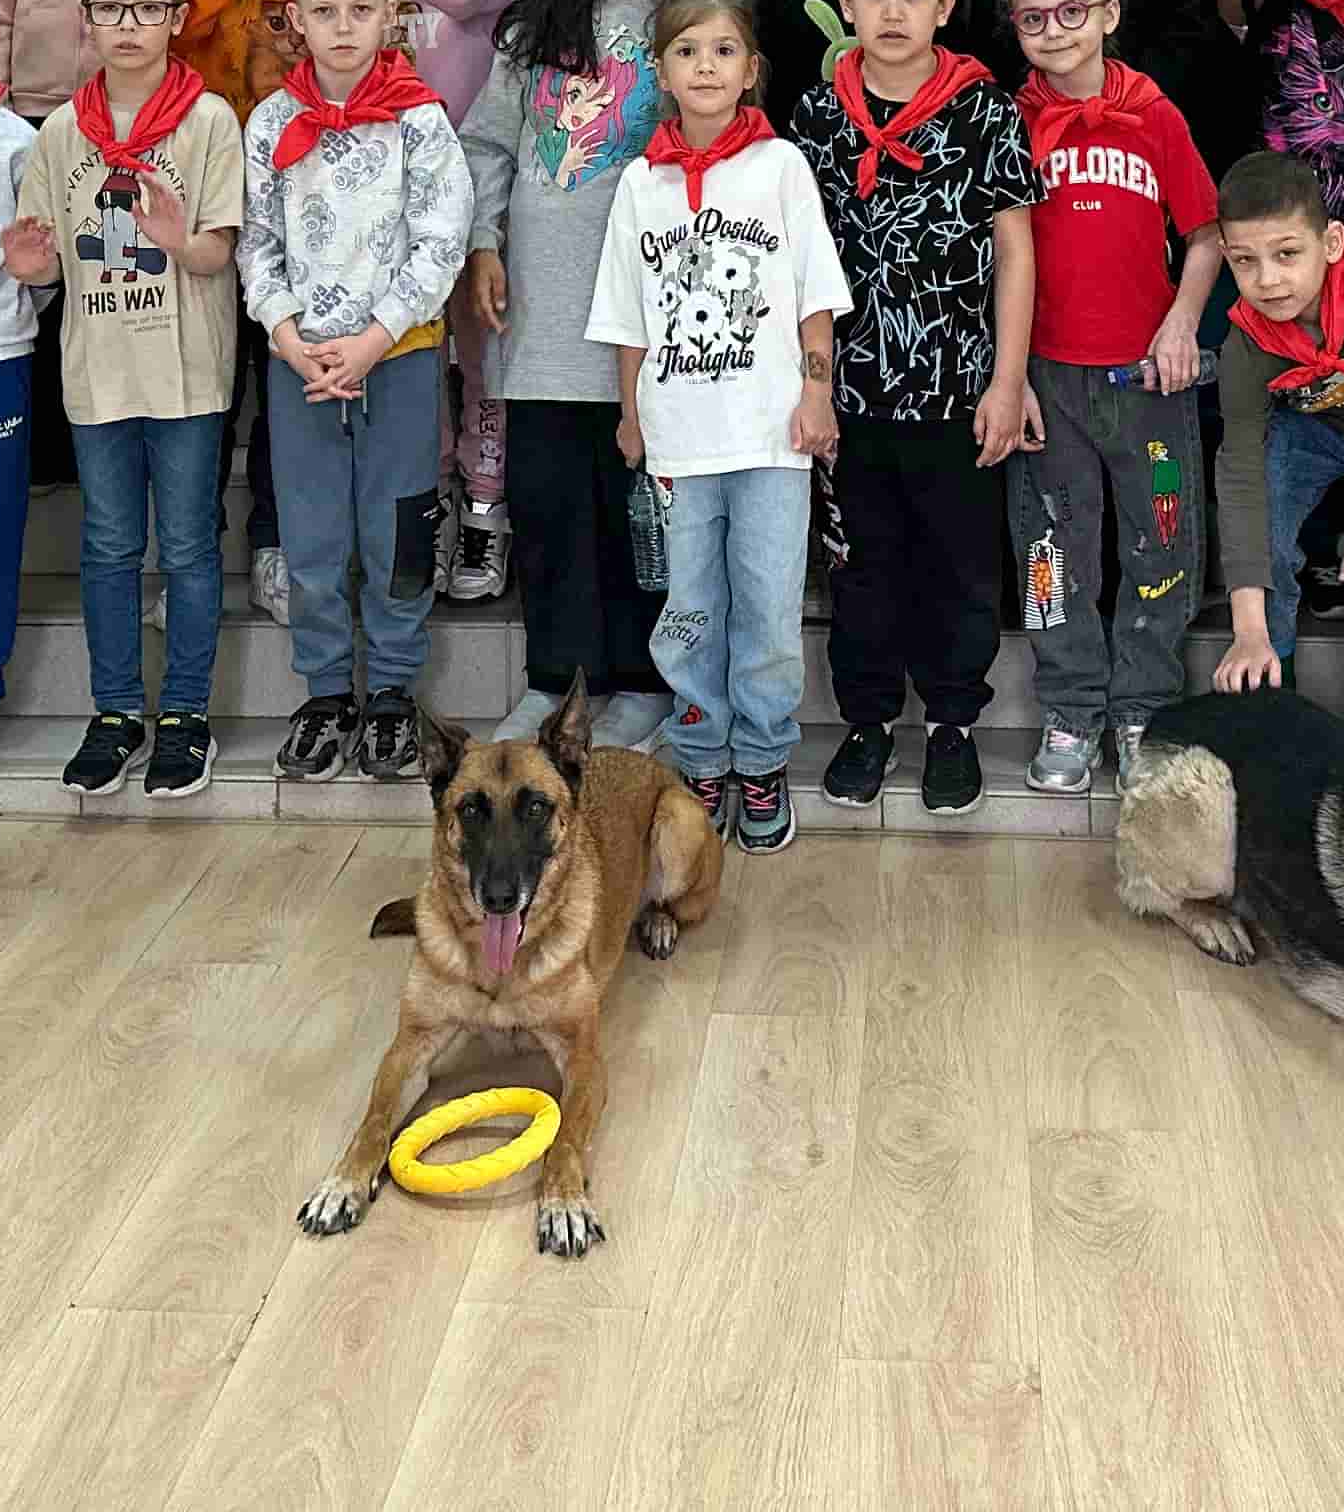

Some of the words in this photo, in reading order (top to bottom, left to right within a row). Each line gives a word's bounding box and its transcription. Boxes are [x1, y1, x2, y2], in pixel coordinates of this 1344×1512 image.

[1072, 200, 1102, 210] CLUB
[640, 223, 690, 275] Grow
[692, 206, 781, 253] Positive
[82, 291, 117, 316] THIS
[124, 284, 166, 312] WAY
[656, 342, 755, 383] Thoughts
